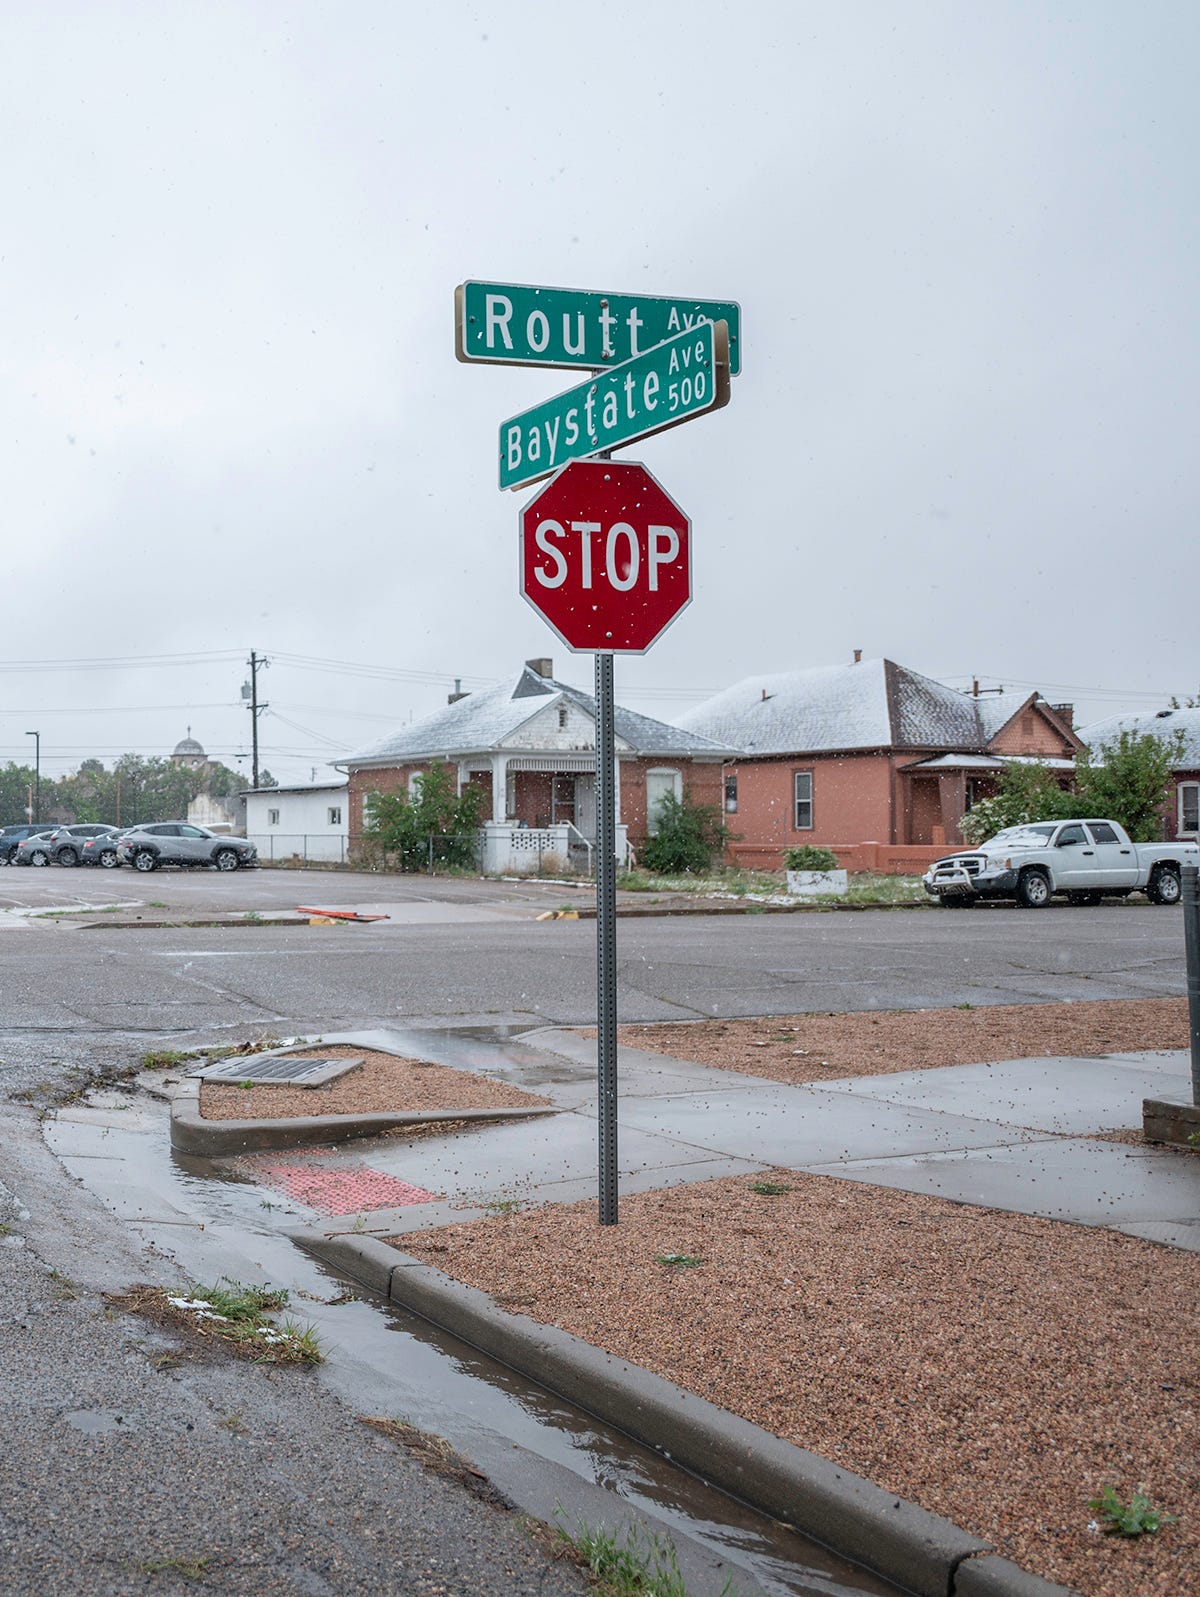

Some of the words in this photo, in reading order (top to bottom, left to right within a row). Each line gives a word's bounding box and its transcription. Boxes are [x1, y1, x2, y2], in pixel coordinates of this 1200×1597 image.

[485, 293, 644, 357] Routt
[507, 370, 660, 472] Baystate
[668, 340, 705, 376] Ave
[668, 371, 706, 412] 500
[533, 518, 680, 592] STOP
